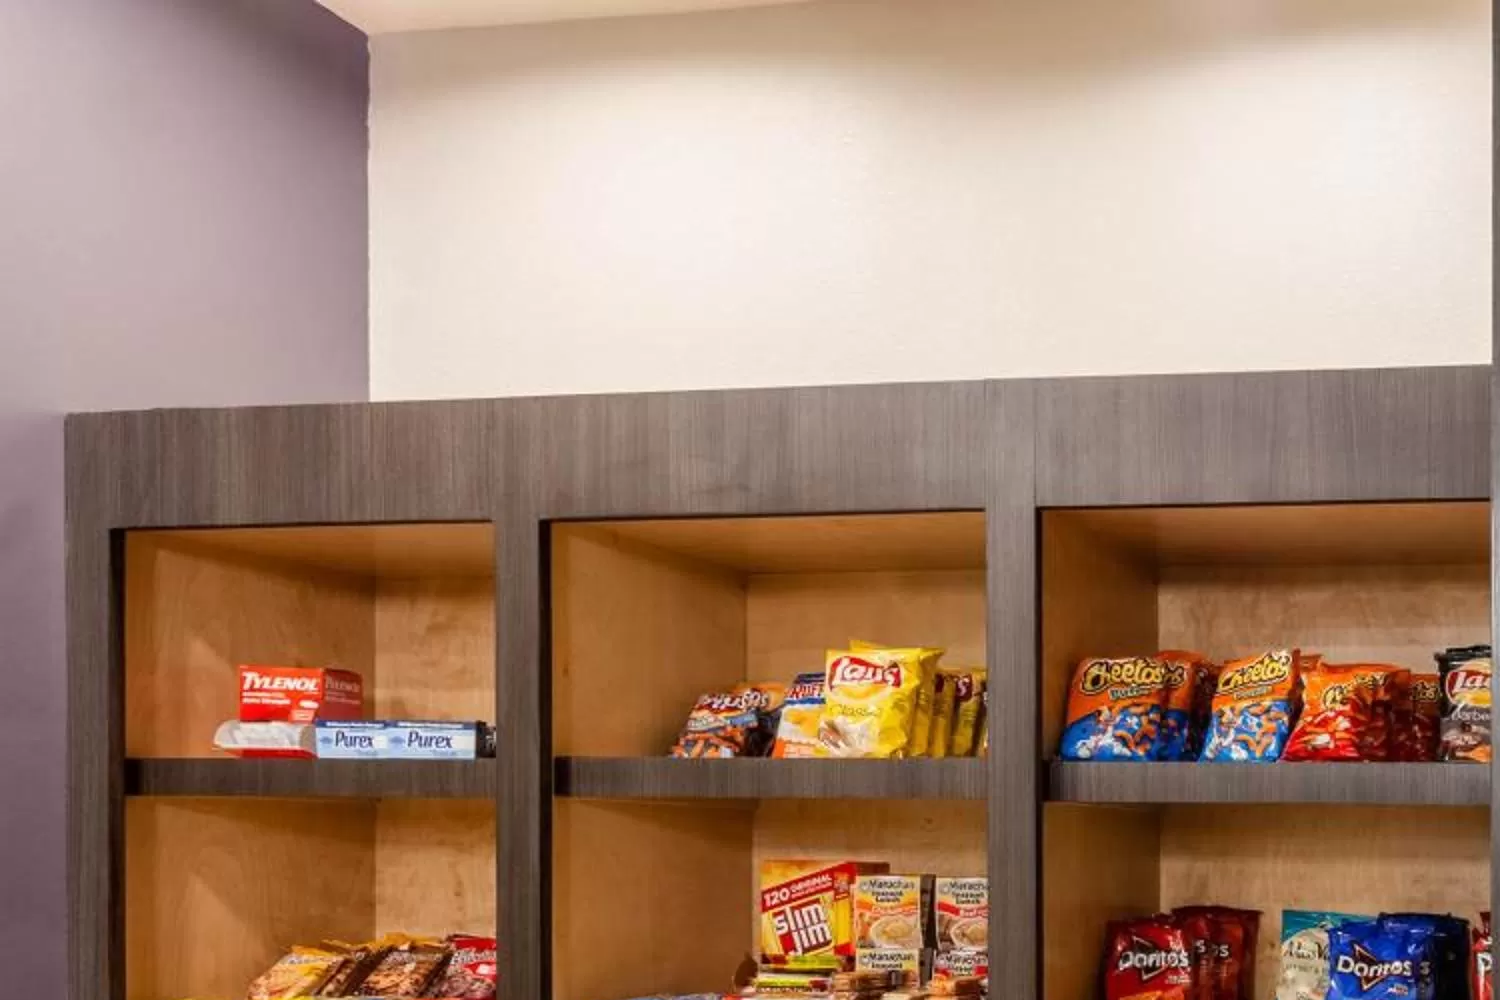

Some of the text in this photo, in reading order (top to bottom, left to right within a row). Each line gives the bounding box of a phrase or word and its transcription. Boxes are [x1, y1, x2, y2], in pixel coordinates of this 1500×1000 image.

[241, 671, 319, 692] TYLENOL
[1083, 659, 1165, 692] Cheetos
[335, 730, 375, 750] Purex
[407, 730, 454, 750] Purex
[763, 888, 791, 907] 120
[1118, 950, 1190, 970] Doritos
[1337, 955, 1413, 978] Doritos
